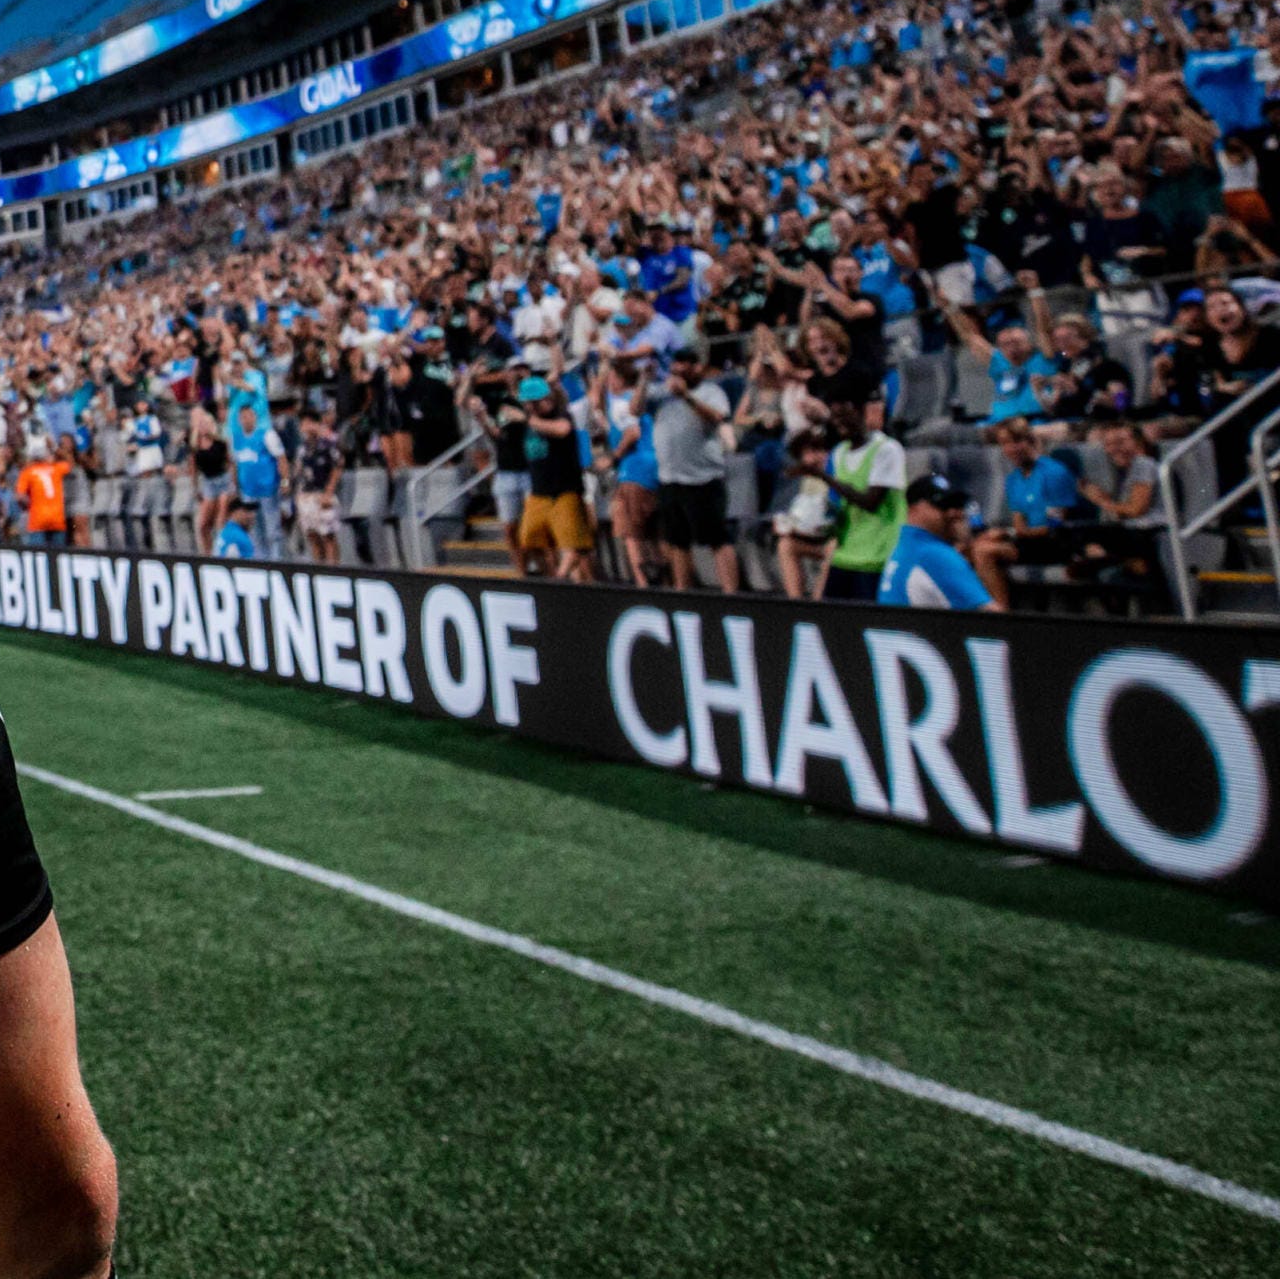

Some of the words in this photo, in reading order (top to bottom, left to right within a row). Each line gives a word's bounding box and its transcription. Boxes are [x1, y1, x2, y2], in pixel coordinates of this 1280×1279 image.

[299, 61, 362, 113] GOAL
[139, 558, 414, 704] PARTNER
[420, 583, 540, 727] OF
[606, 606, 1280, 882] CHARLO
